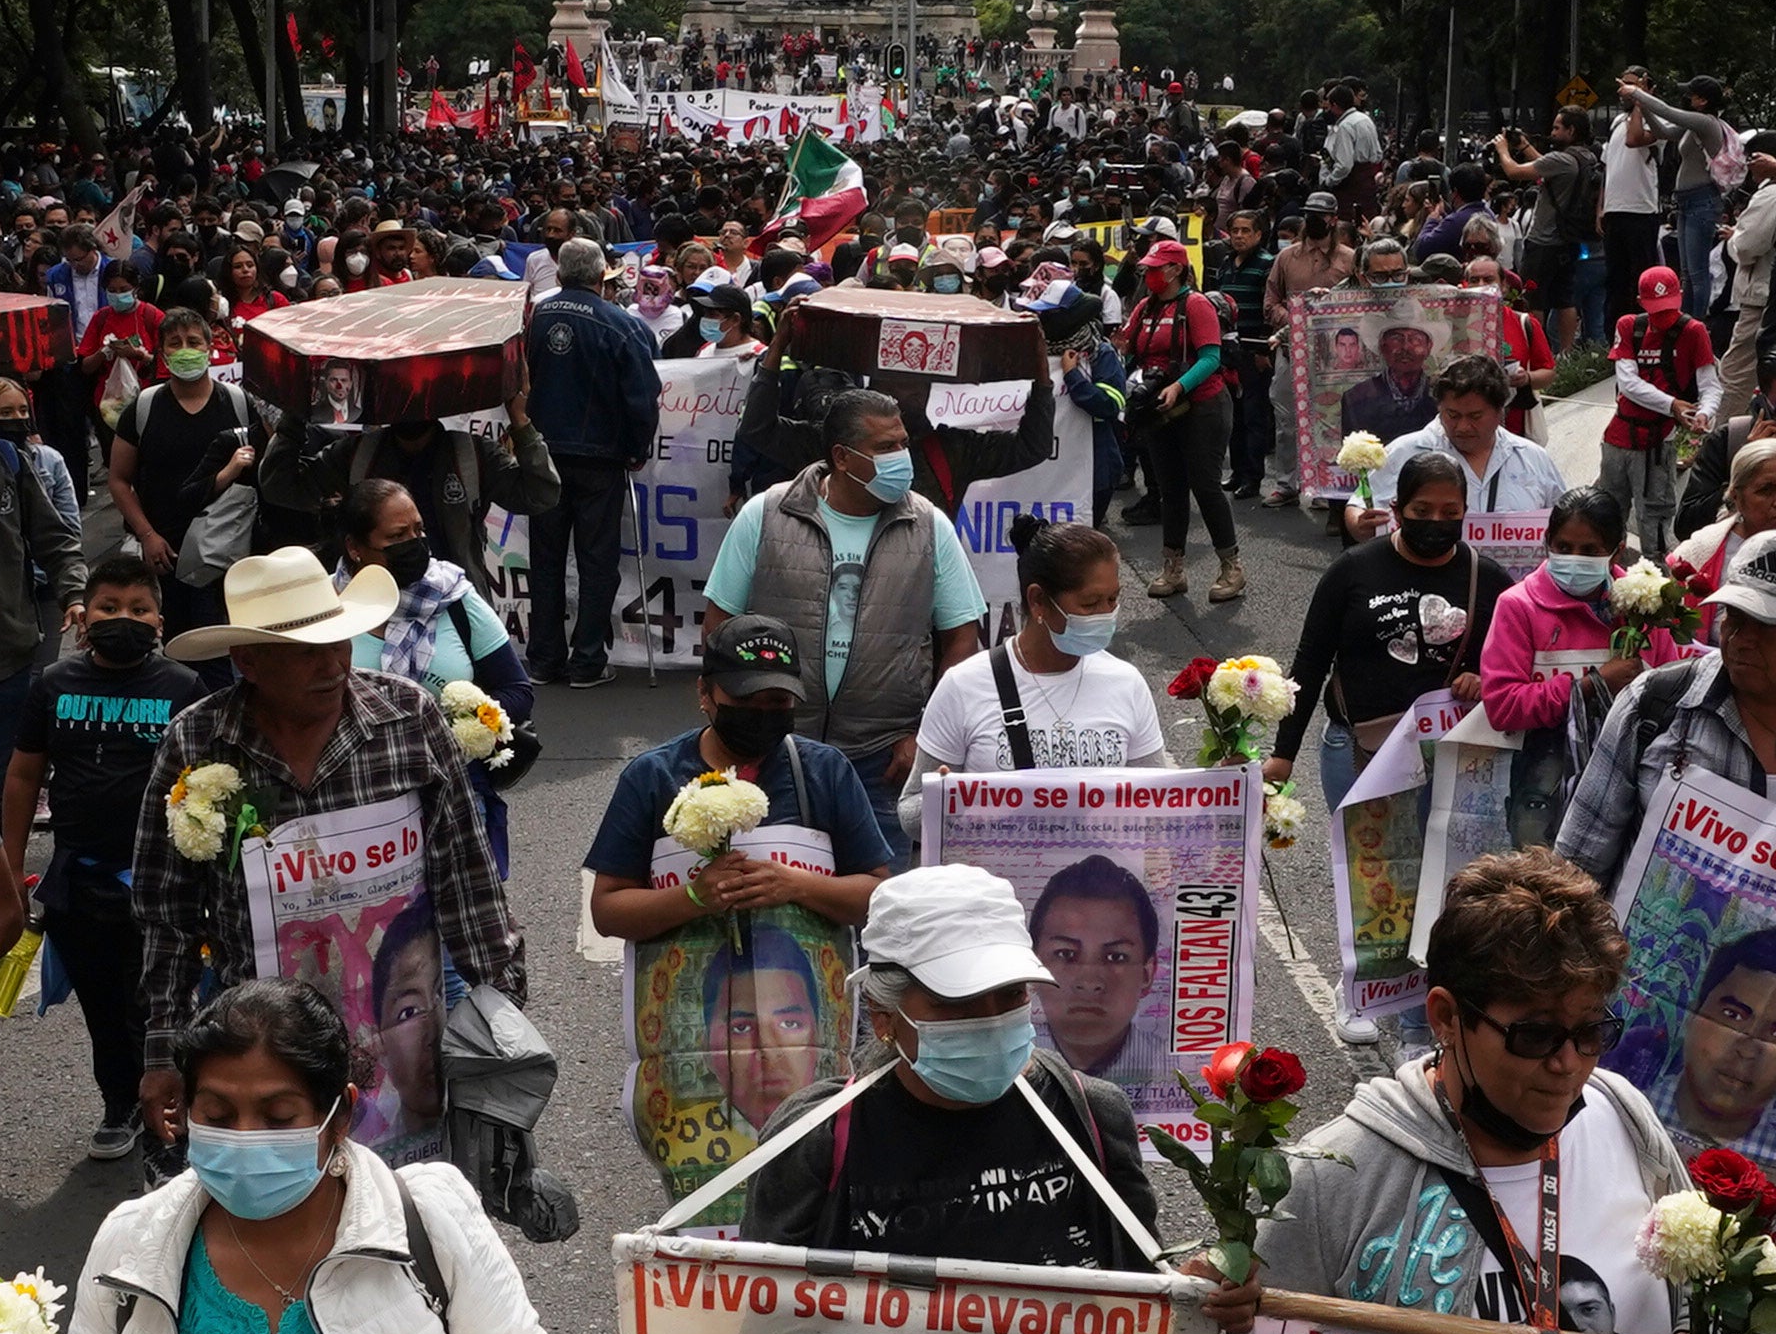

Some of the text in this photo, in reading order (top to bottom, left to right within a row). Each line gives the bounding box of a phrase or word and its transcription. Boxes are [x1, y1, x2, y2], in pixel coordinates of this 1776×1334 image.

[542, 301, 594, 315] AYOTZINAPA
[1468, 523, 1486, 541] lo
[735, 635, 792, 658] AYOTZINAPA
[56, 694, 172, 722] OUTWORK
[949, 779, 1240, 814] ¡Vivo se lo llevaron!
[1669, 798, 1748, 854] ¡Vivo
[274, 826, 419, 893] ¡Vivo se lo
[281, 899, 301, 912] Yo,
[1175, 884, 1238, 1053] NOS FALTAN 43!
[1360, 972, 1421, 1008] ¡Vivo lo
[651, 1261, 778, 1318] ¡Vivo
[792, 1278, 846, 1322] se
[863, 1278, 909, 1329] lo
